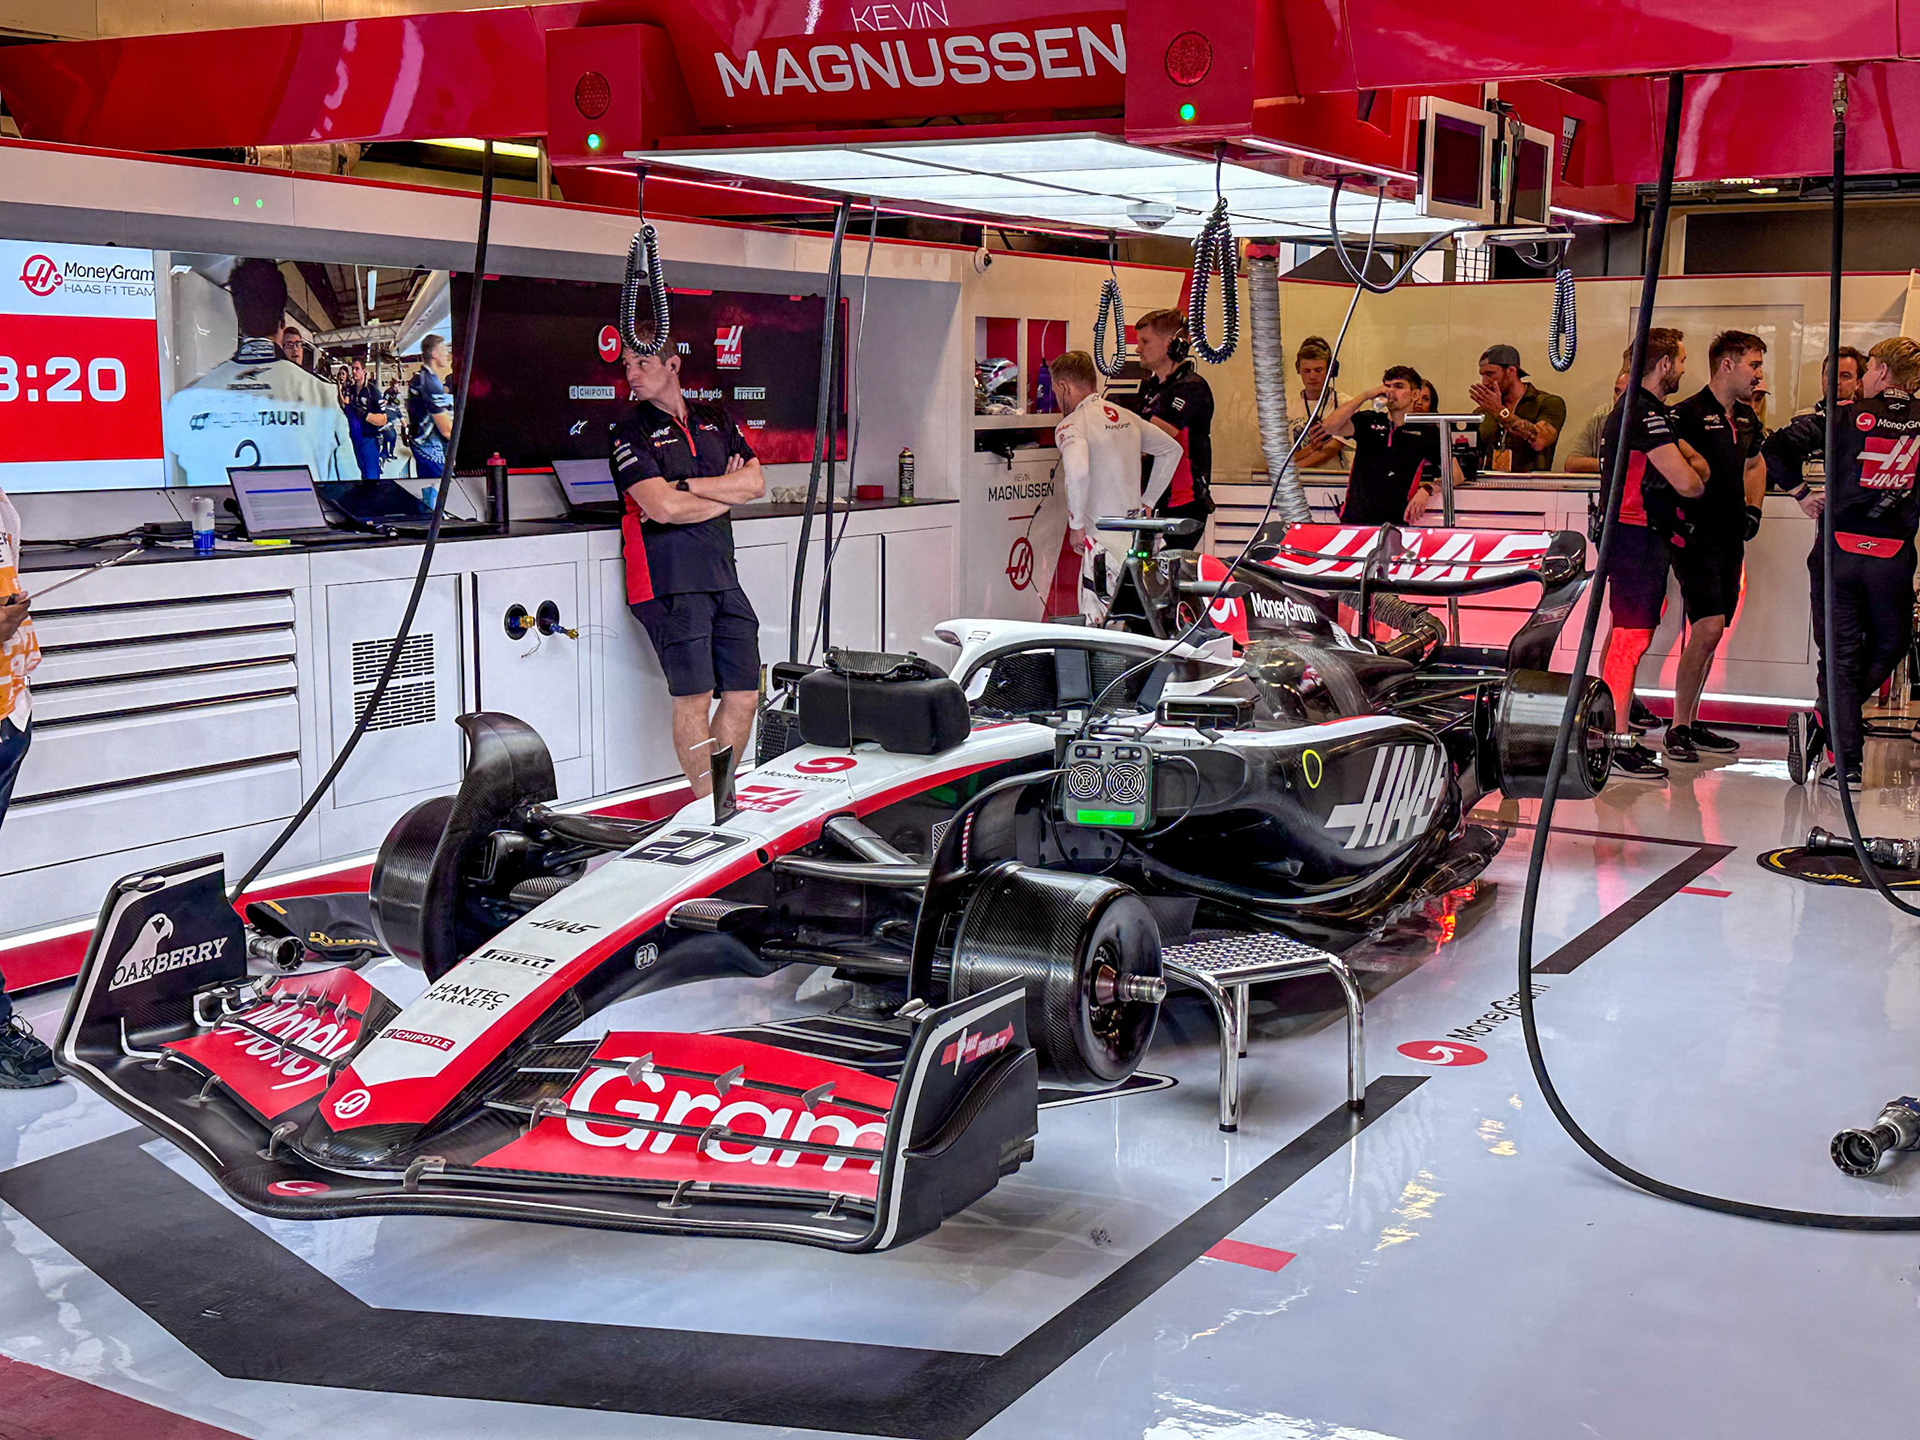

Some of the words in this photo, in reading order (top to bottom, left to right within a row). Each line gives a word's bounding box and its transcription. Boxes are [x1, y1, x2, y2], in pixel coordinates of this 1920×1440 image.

[850, 0, 950, 33] KEVIN
[713, 23, 1127, 98] MAGNUSSEN
[64, 261, 155, 283] MoneyGram
[64, 283, 101, 294] HAAS
[104, 285, 117, 295] F1
[120, 286, 156, 297] TEAM
[578, 387, 614, 398] CHIPOTLE
[734, 387, 766, 400] PIRELLI
[1877, 418, 1920, 431] MoneyGr
[1860, 472, 1915, 488] HAAS
[988, 482, 1055, 502] MAGNUSSEN
[1249, 592, 1317, 626] MoneyGram
[757, 770, 847, 784] MoneyGram
[1324, 743, 1449, 850] HAAS
[622, 828, 751, 867] 20
[528, 918, 602, 935] HAAS
[112, 936, 229, 987] OAKBERRY
[479, 948, 556, 970] PIRELLI
[636, 945, 657, 967] FIA
[424, 991, 499, 1012] MARKETS
[433, 982, 510, 1004] HANTEC
[214, 1002, 358, 1090] Money
[394, 1030, 453, 1050] CHIPOTLE
[565, 1056, 889, 1176] Gram
